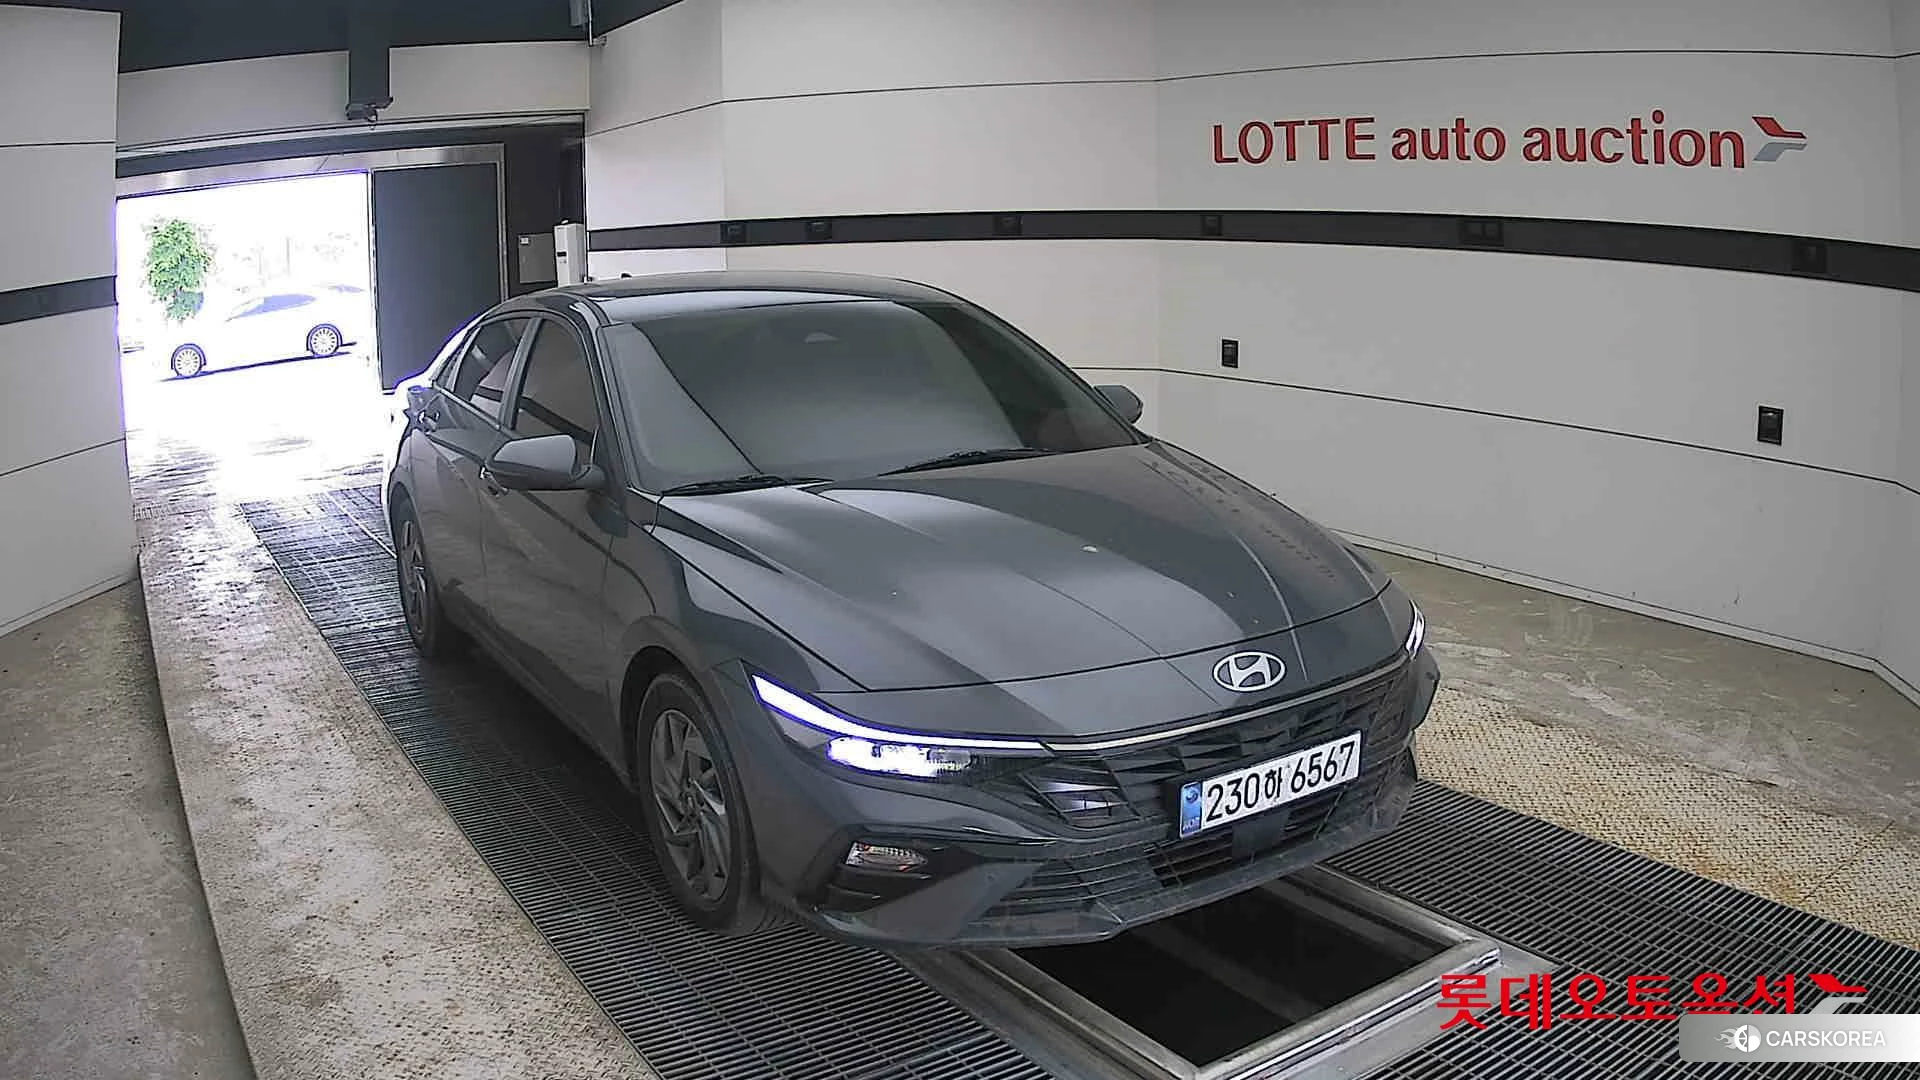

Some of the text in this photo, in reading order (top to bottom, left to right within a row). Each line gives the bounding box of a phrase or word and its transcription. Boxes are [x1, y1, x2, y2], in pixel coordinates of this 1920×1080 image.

[1213, 109, 1745, 169] LOTTE auto auction
[1205, 740, 1356, 823] 230하 6567
